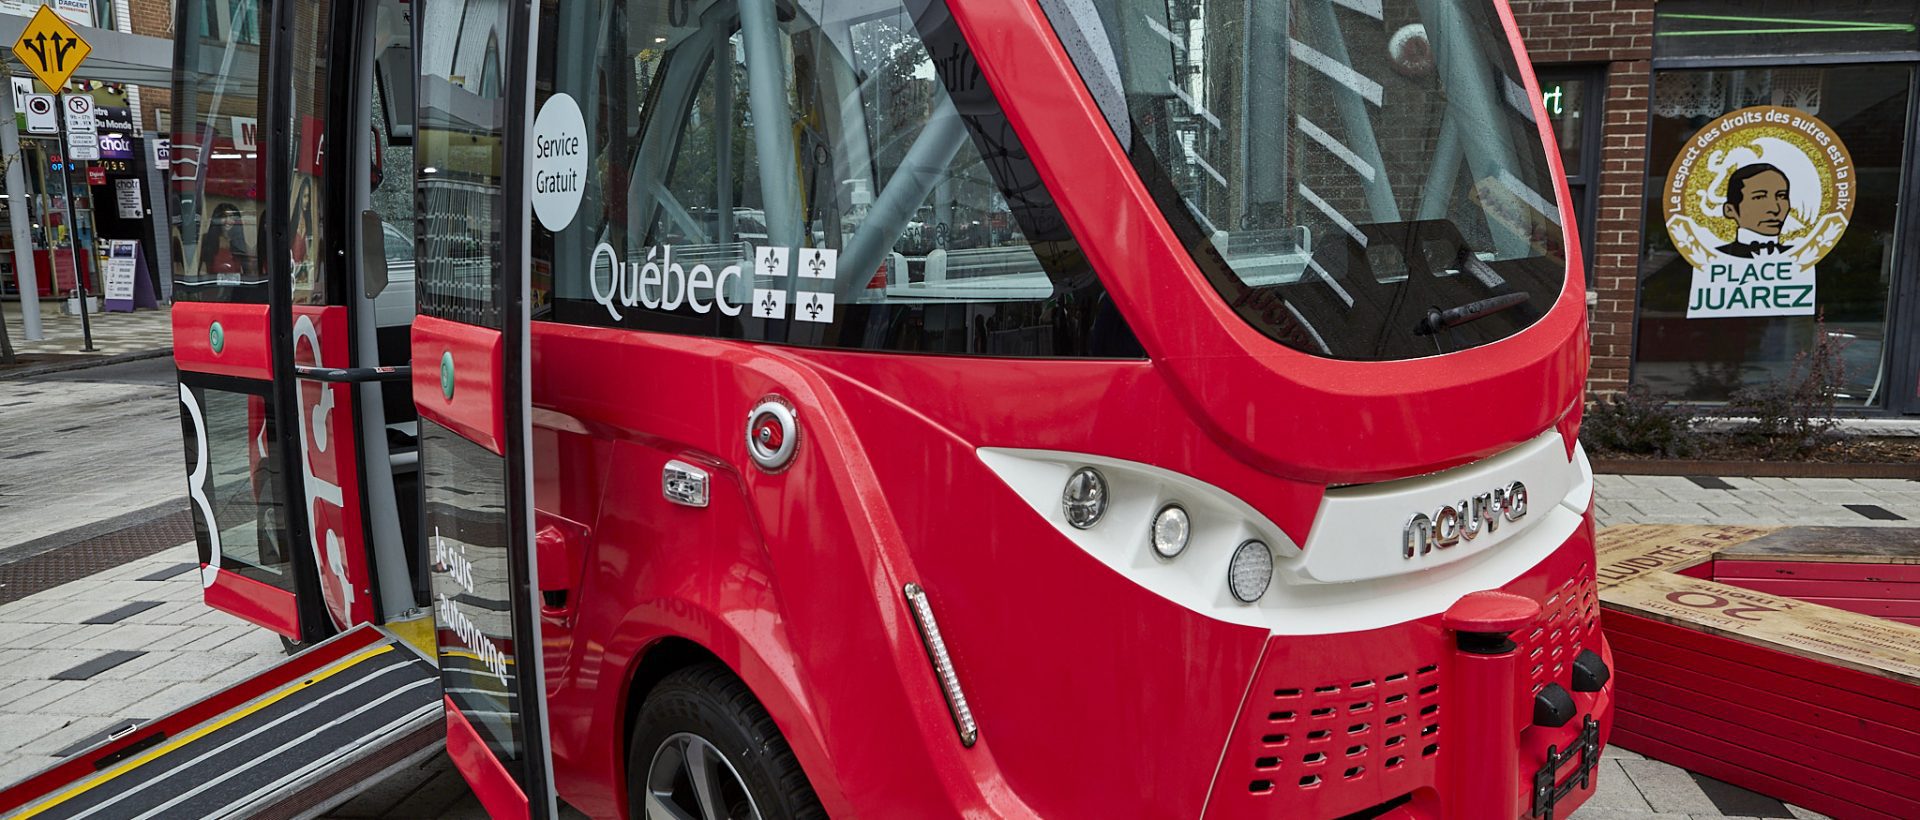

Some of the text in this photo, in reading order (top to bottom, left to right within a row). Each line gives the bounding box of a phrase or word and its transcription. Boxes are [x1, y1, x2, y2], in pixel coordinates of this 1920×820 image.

[106, 120, 132, 130] Monde
[536, 132, 579, 159] Service
[1669, 109, 1851, 213] Le respect des droits des autres est la paix
[536, 170, 577, 194] Gratuit
[589, 242, 744, 322] Québec
[1710, 262, 1793, 284] PLACE
[435, 525, 474, 594] Je suis
[1665, 591, 1781, 621] 20
[440, 592, 508, 687] autonome
